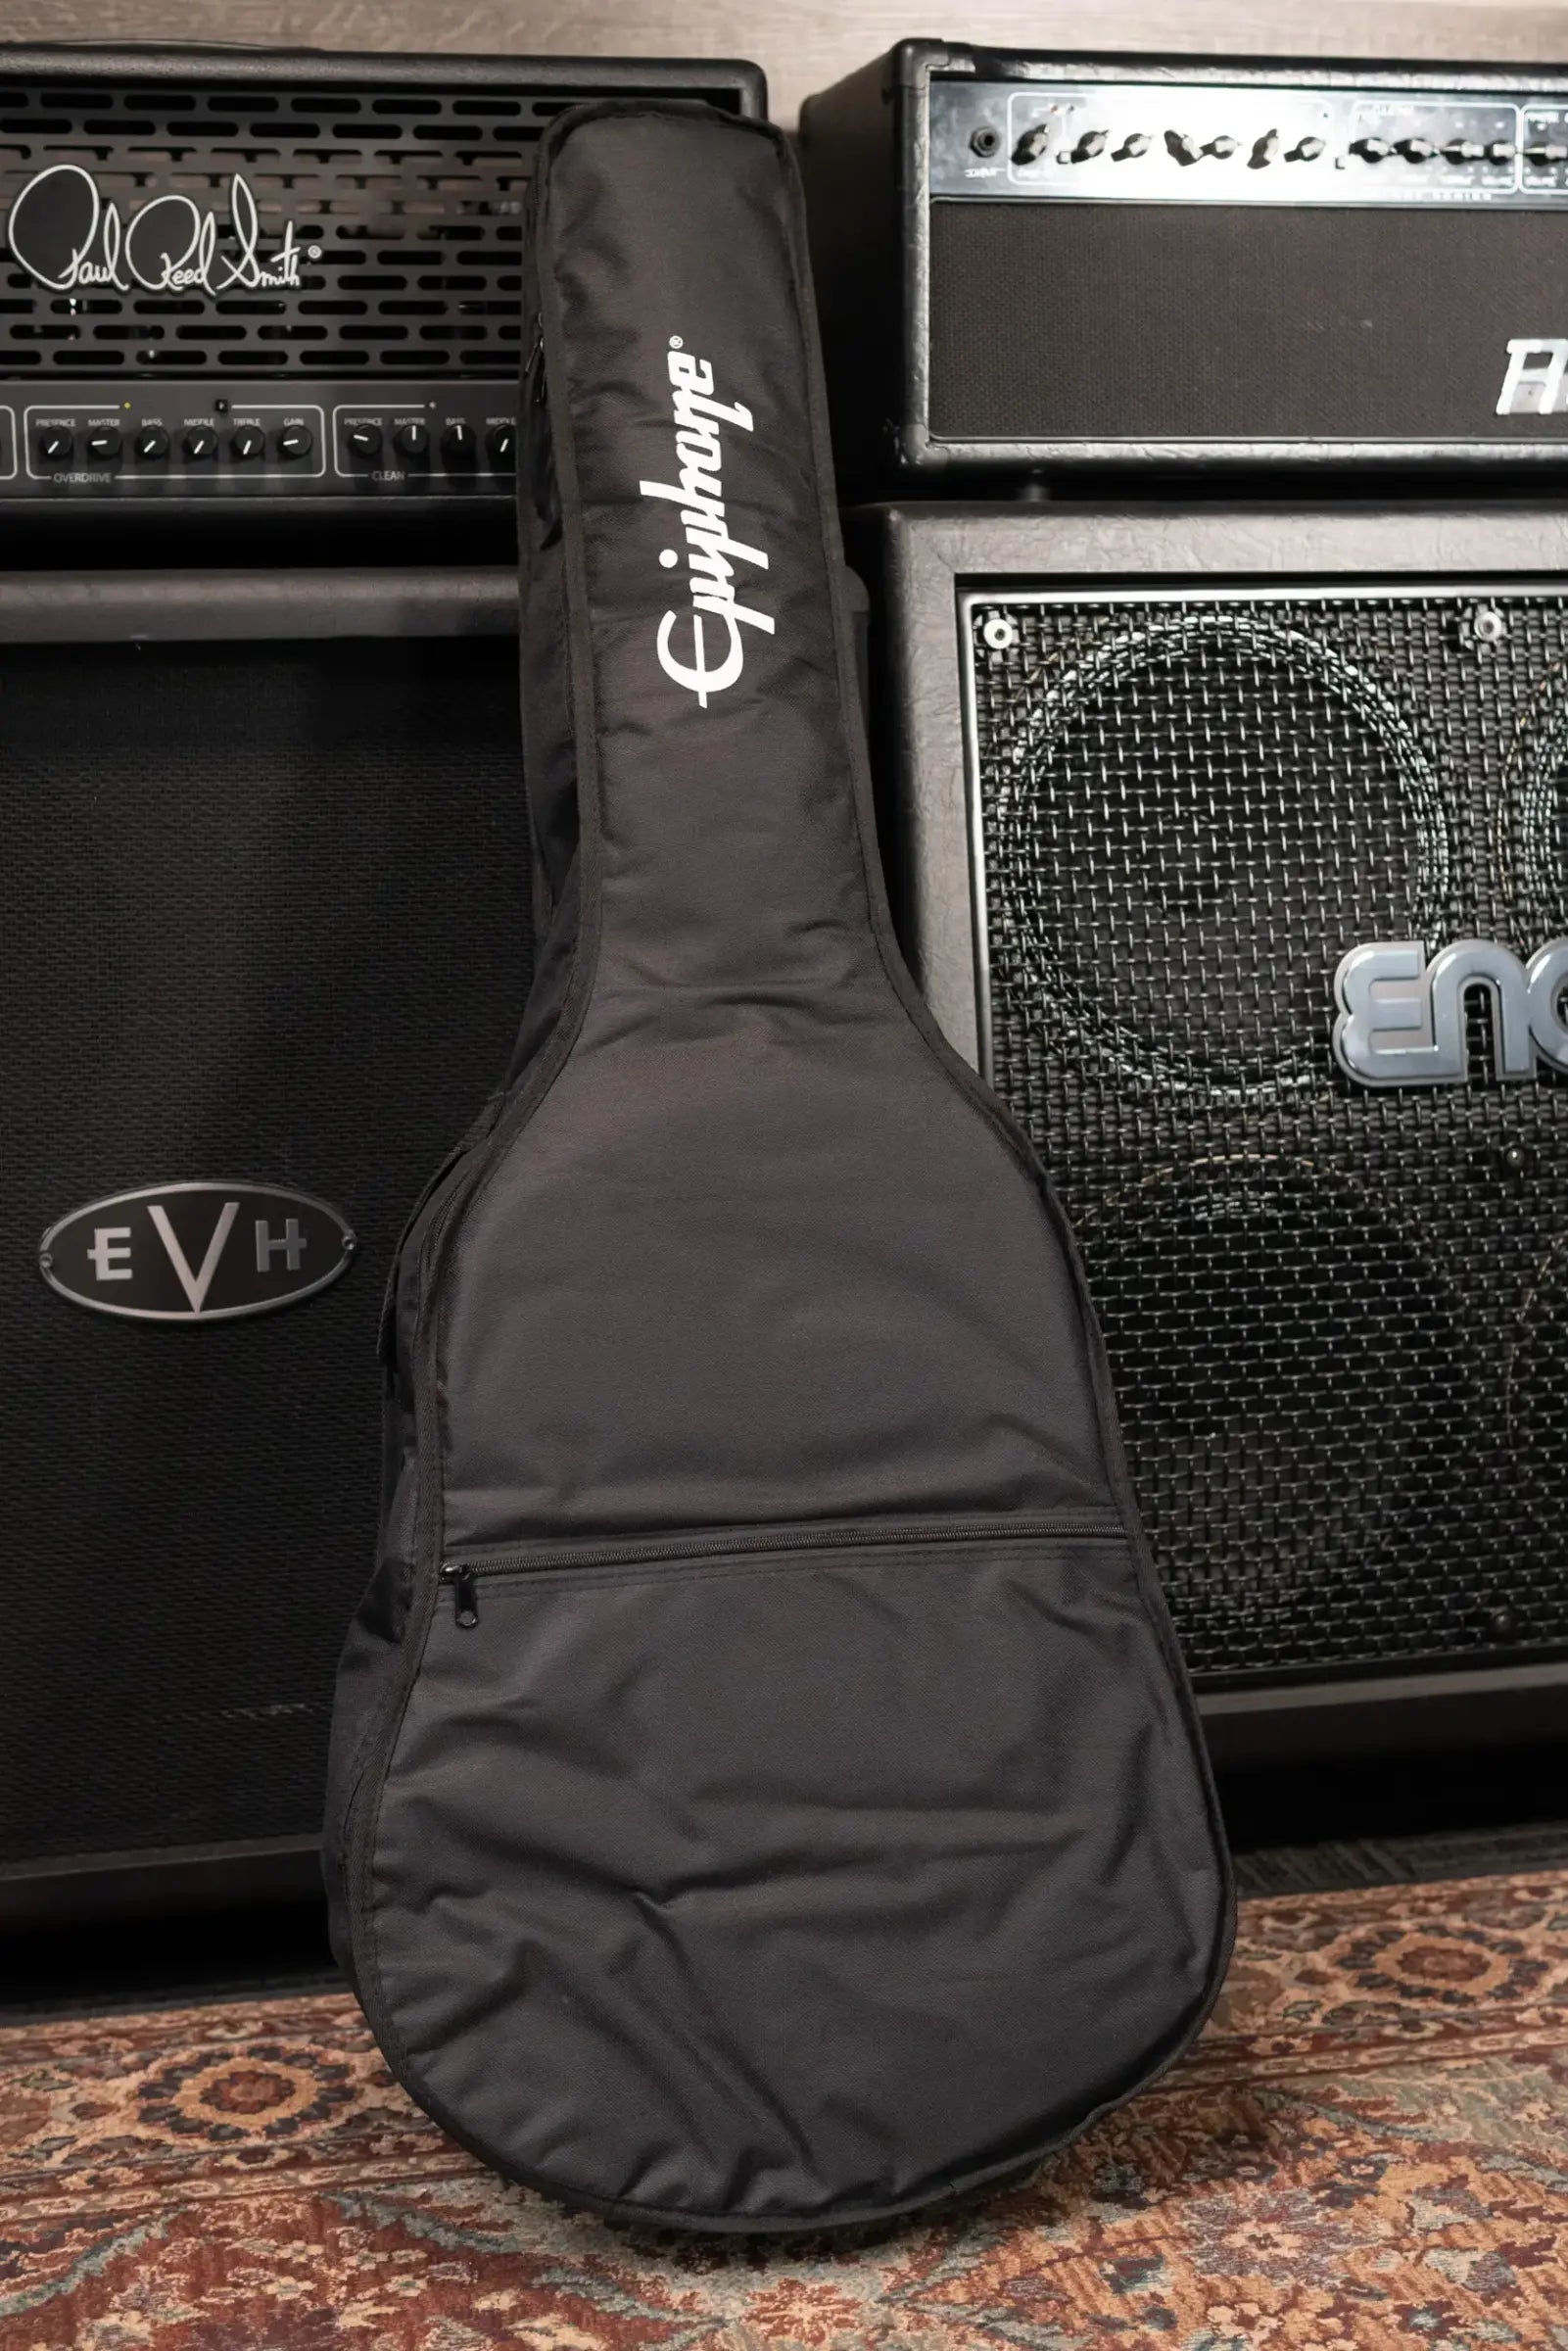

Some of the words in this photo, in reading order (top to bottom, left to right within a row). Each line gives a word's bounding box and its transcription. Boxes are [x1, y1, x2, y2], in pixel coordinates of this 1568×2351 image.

[8, 164, 129, 291] Paul
[125, 194, 216, 297] Reed
[215, 172, 302, 289] Smith
[35, 418, 76, 428] PRESENCE
[87, 418, 121, 427] MASTER
[141, 418, 164, 427] BASS
[183, 418, 215, 427] MIDDLE
[232, 418, 261, 427] TREBLE
[282, 417, 305, 427] GAIN
[344, 417, 383, 427] PRESENCE
[393, 416, 426, 426] MASTER
[53, 472, 112, 484] OVERDRIVE
[371, 470, 405, 482] CLEAN
[640, 350, 776, 709] Epiphone
[87, 1201, 308, 1314] EVH
